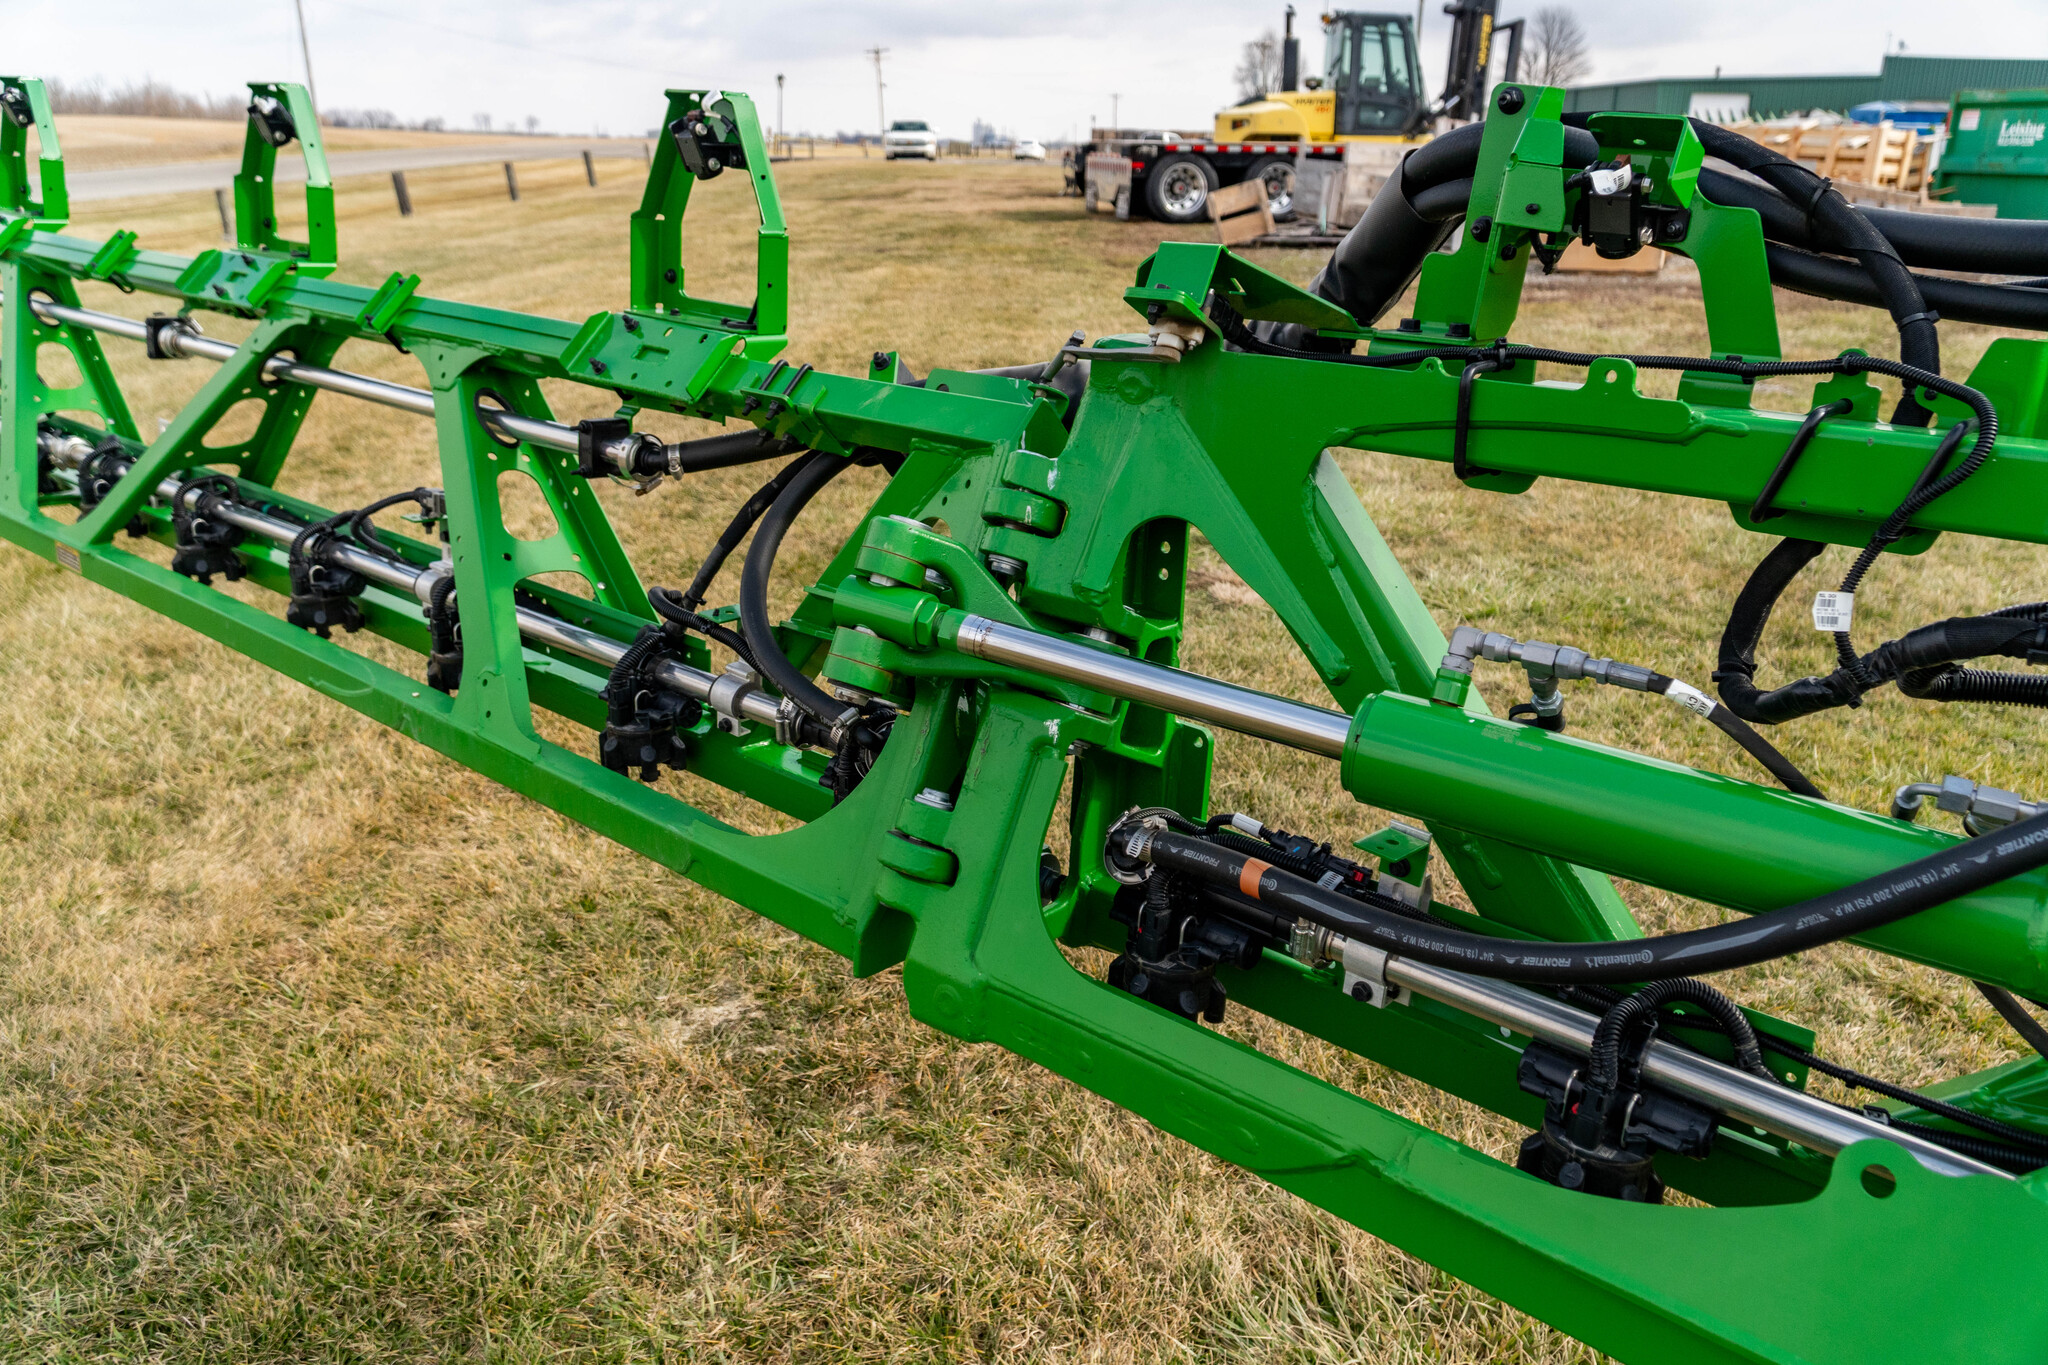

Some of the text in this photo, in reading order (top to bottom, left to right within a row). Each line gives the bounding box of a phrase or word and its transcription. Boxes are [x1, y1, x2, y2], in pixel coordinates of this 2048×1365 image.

[1996, 827, 2048, 856] RONTIER
[1183, 848, 1220, 867] FRONTIER
[1891, 869, 1939, 896] (19.1mm)
[1873, 888, 1892, 902] 200
[1831, 903, 1855, 917] W.P.
[1856, 896, 1874, 910] PSI
[1401, 932, 1417, 946] W.P.
[1417, 937, 1430, 949] PSI
[1431, 941, 1444, 953] 200
[1446, 943, 1479, 960] (19.1mm)
[1522, 956, 1571, 968] FRONTIER
[1592, 949, 1654, 968] Continental
